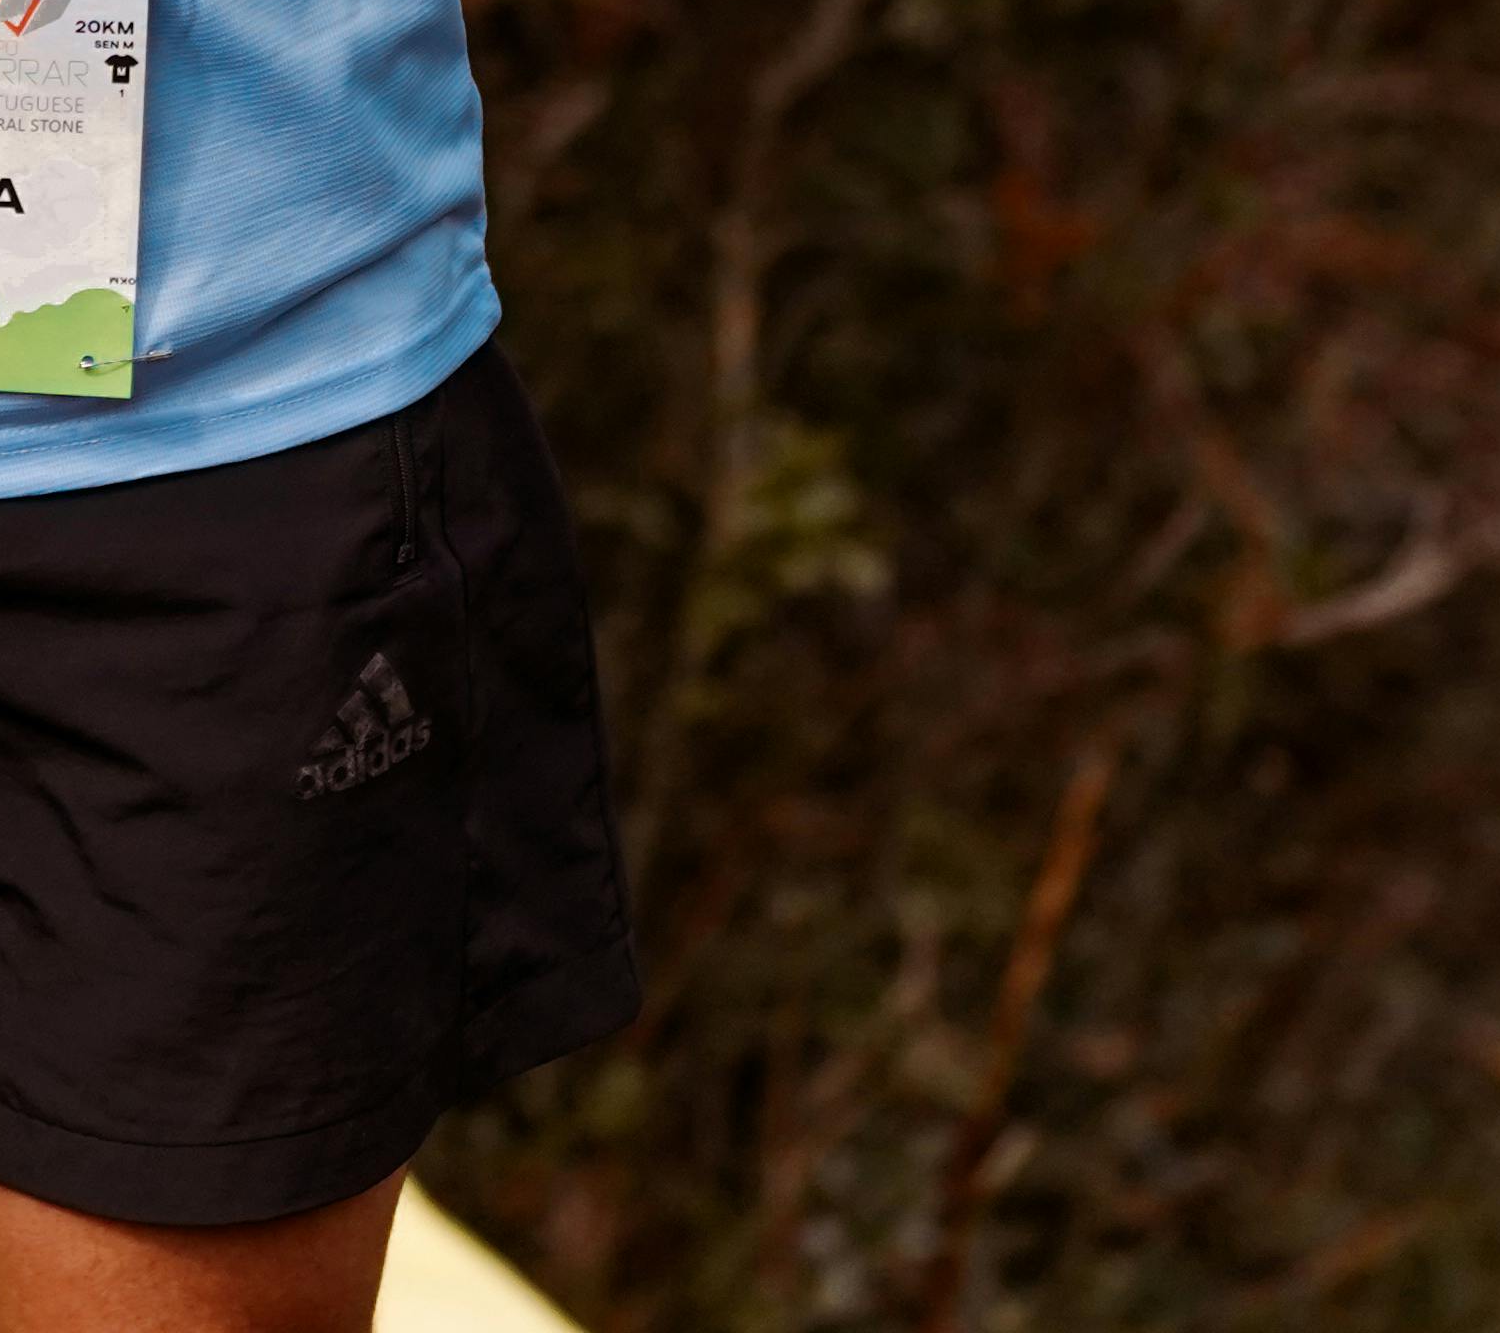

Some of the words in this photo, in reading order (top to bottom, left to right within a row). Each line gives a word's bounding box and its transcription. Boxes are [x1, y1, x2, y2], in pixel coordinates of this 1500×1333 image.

[75, 20, 134, 35] 20KM
[94, 40, 119, 49] SEN
[123, 41, 134, 50] M
[28, 118, 84, 134] STONE
[297, 717, 433, 801] adidas
